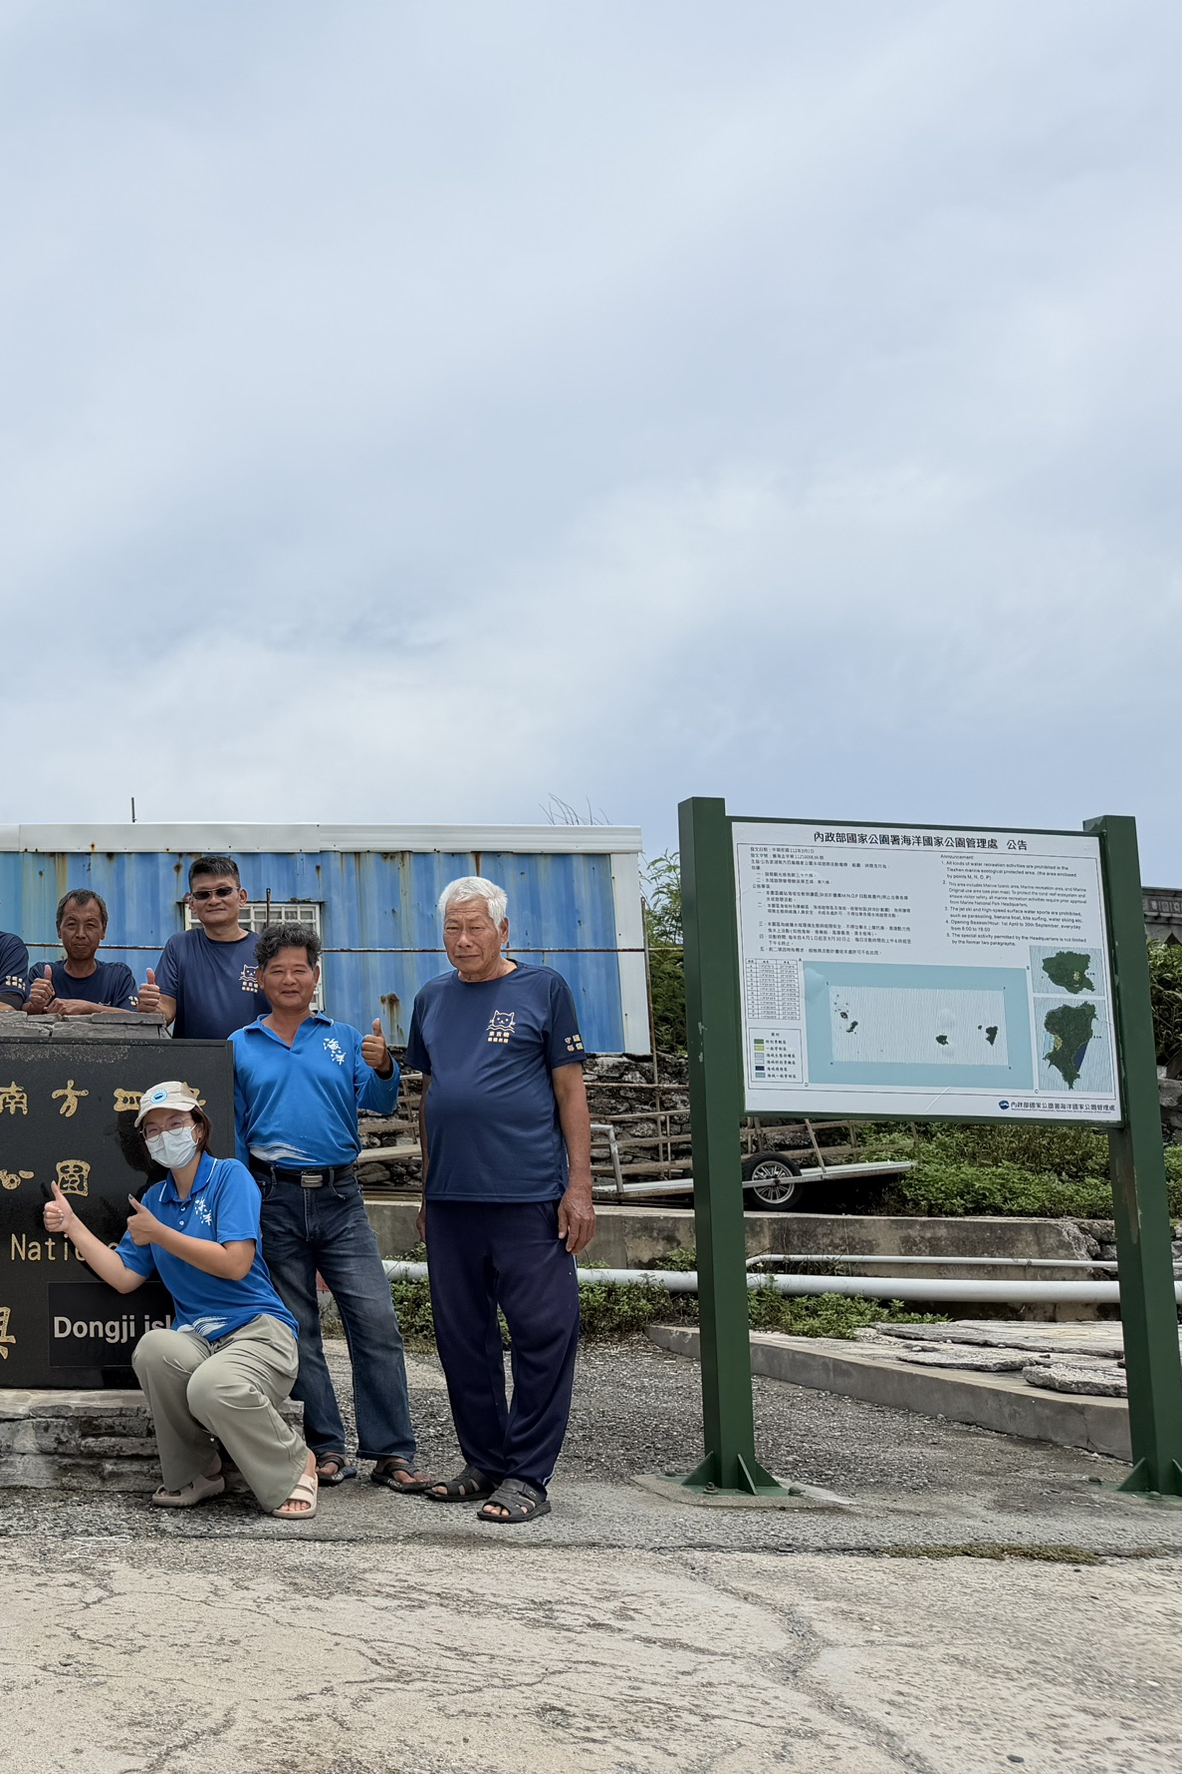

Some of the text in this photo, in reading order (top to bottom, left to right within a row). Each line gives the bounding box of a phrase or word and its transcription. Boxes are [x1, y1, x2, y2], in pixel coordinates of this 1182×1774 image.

[813, 831, 999, 850] 內政部國家公園署海洋國家公園管理處
[1006, 839, 1028, 851] 公告
[1017, 889, 1030, 897] protect
[1057, 891, 1077, 899] ecosystem
[1045, 896, 1059, 904] require
[1070, 897, 1087, 905] approval
[994, 933, 1015, 941] permitted
[1029, 935, 1059, 943] Headquarters
[53, 1315, 136, 1344] Dongji
